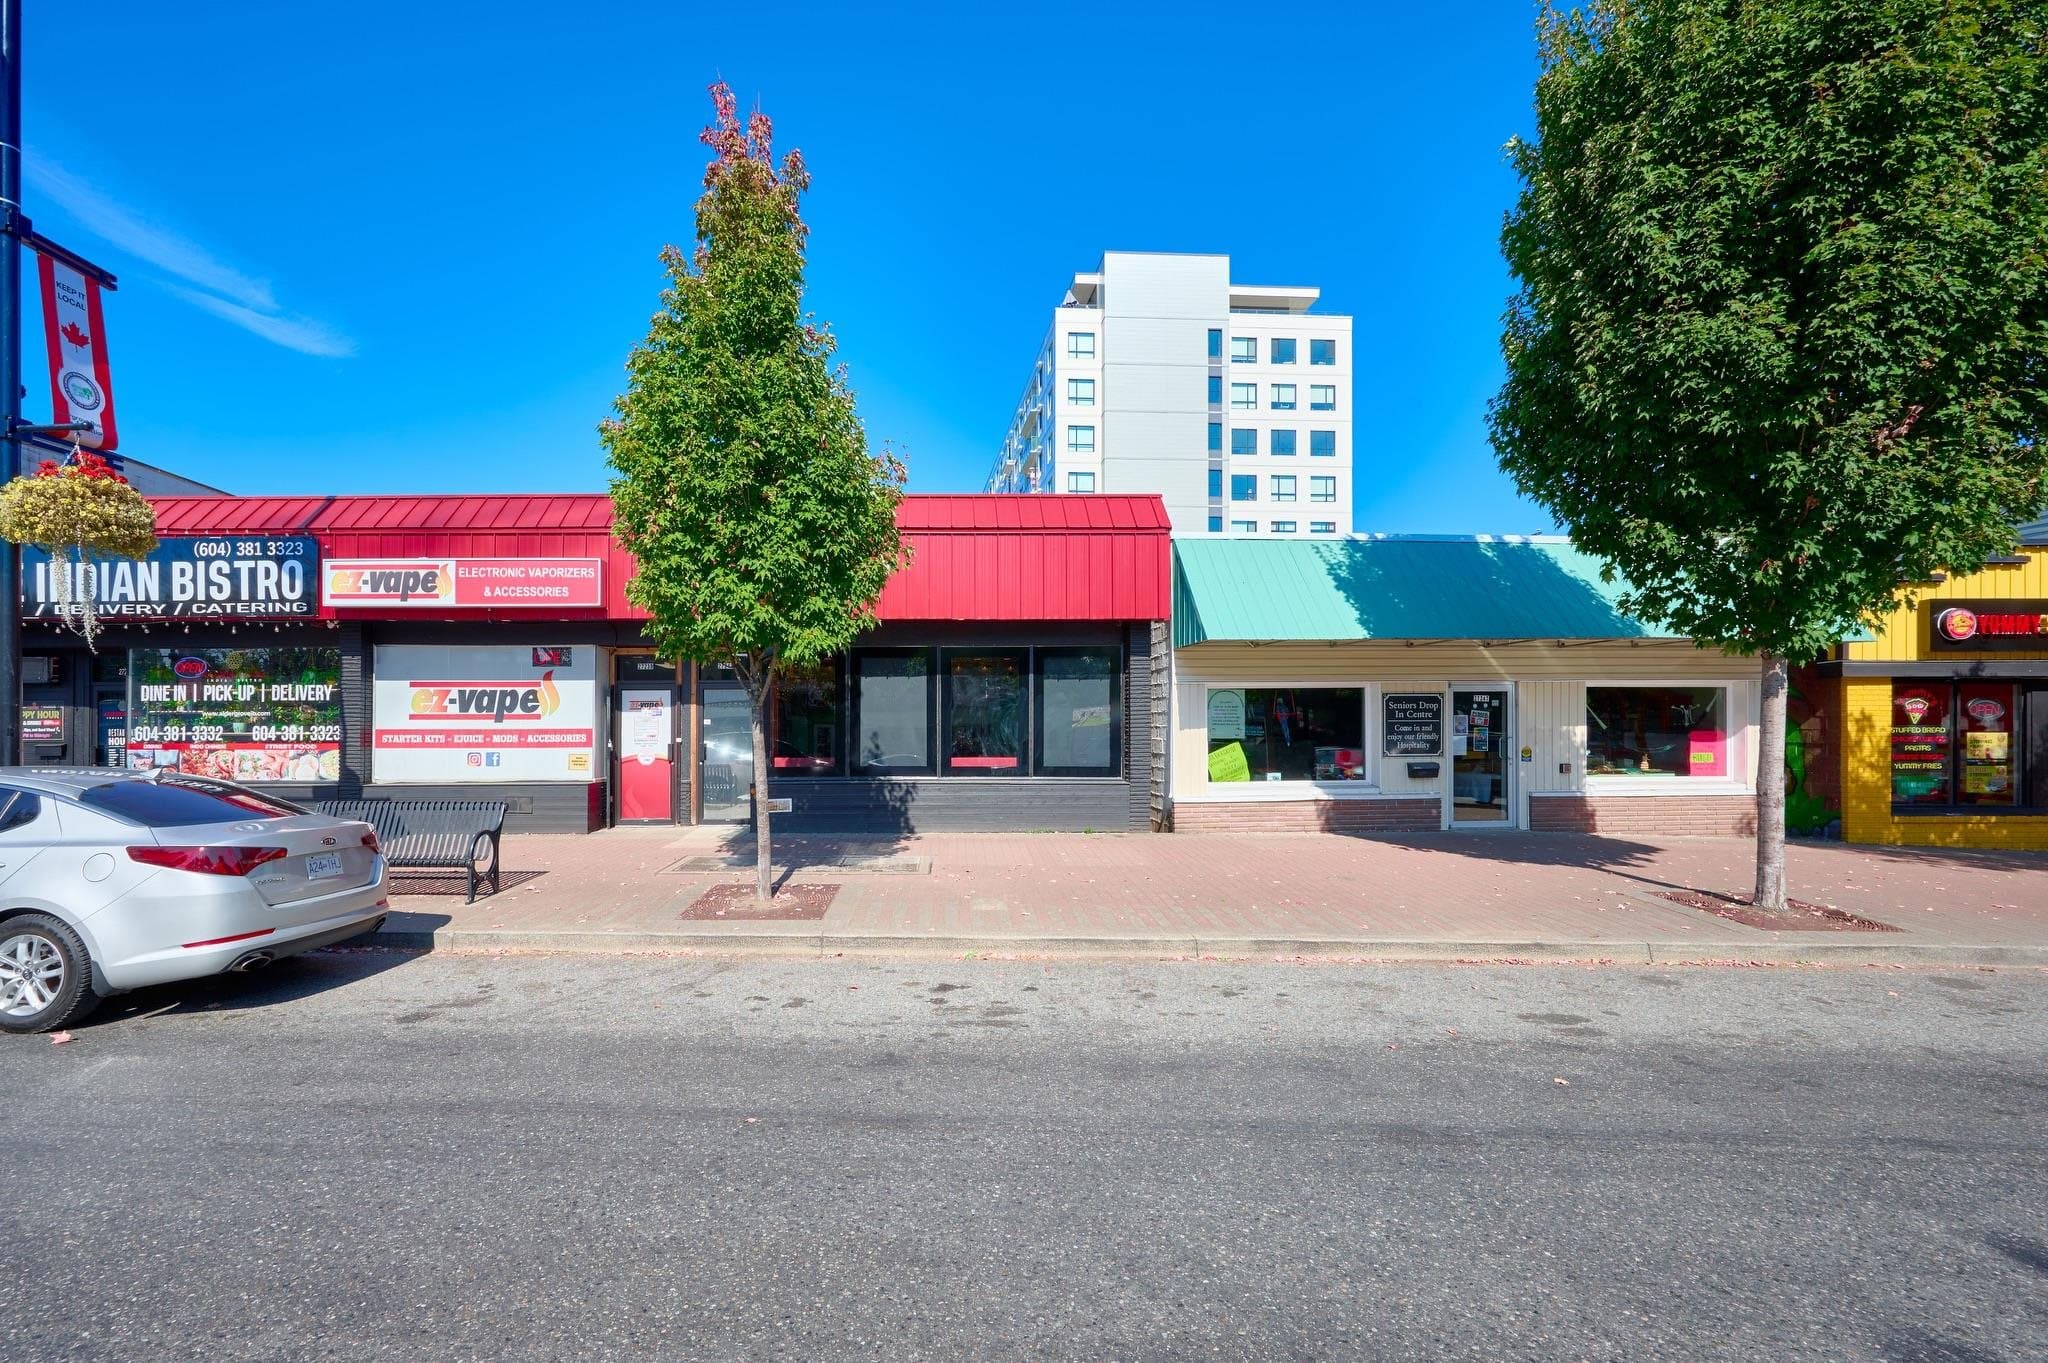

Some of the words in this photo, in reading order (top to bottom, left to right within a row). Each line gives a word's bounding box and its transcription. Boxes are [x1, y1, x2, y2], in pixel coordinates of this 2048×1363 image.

[56, 280, 77, 295] KEEP
[78, 291, 86, 300] IT
[57, 291, 86, 311] LOCAL
[194, 542, 231, 557] (604)
[236, 542, 262, 556] 381
[267, 542, 303, 556] 3323
[458, 566, 525, 578] ELECTRONIC
[528, 566, 595, 578] VAPORIZERS
[172, 559, 303, 600] BISTRO
[331, 570, 439, 602] ez-vape
[483, 586, 492, 597] &
[494, 585, 569, 597] ACCESSORIES
[54, 603, 165, 615] DEIVERY
[192, 601, 308, 614] CATERING
[141, 685, 170, 701] DINE
[173, 685, 187, 701] IN
[204, 685, 255, 701] PICK-UP
[272, 684, 333, 701] DELIVERY
[411, 688, 541, 724] ez-vape
[1388, 701, 1417, 709] Seniors
[1420, 701, 1439, 711] Drop
[1969, 704, 2000, 716] OPEN
[37, 710, 59, 719] HOUR
[1395, 710, 1404, 718] In
[1407, 710, 1433, 718] Centre
[1421, 723, 1433, 731] and
[135, 725, 223, 742] 604-381-3332
[252, 725, 341, 742] 604-381-3323
[382, 734, 423, 744] STARTER
[424, 734, 446, 744] KITS
[492, 734, 519, 744] MODS
[527, 734, 587, 744] ACCESSORIES
[1387, 733, 1402, 742] enjoy
[1416, 733, 1439, 742] friendly
[1397, 741, 1431, 750] Hospitality
[1904, 744, 1932, 752] PASTAS
[1894, 762, 1922, 770] YUMMY
[1922, 762, 1943, 770] FRIES
